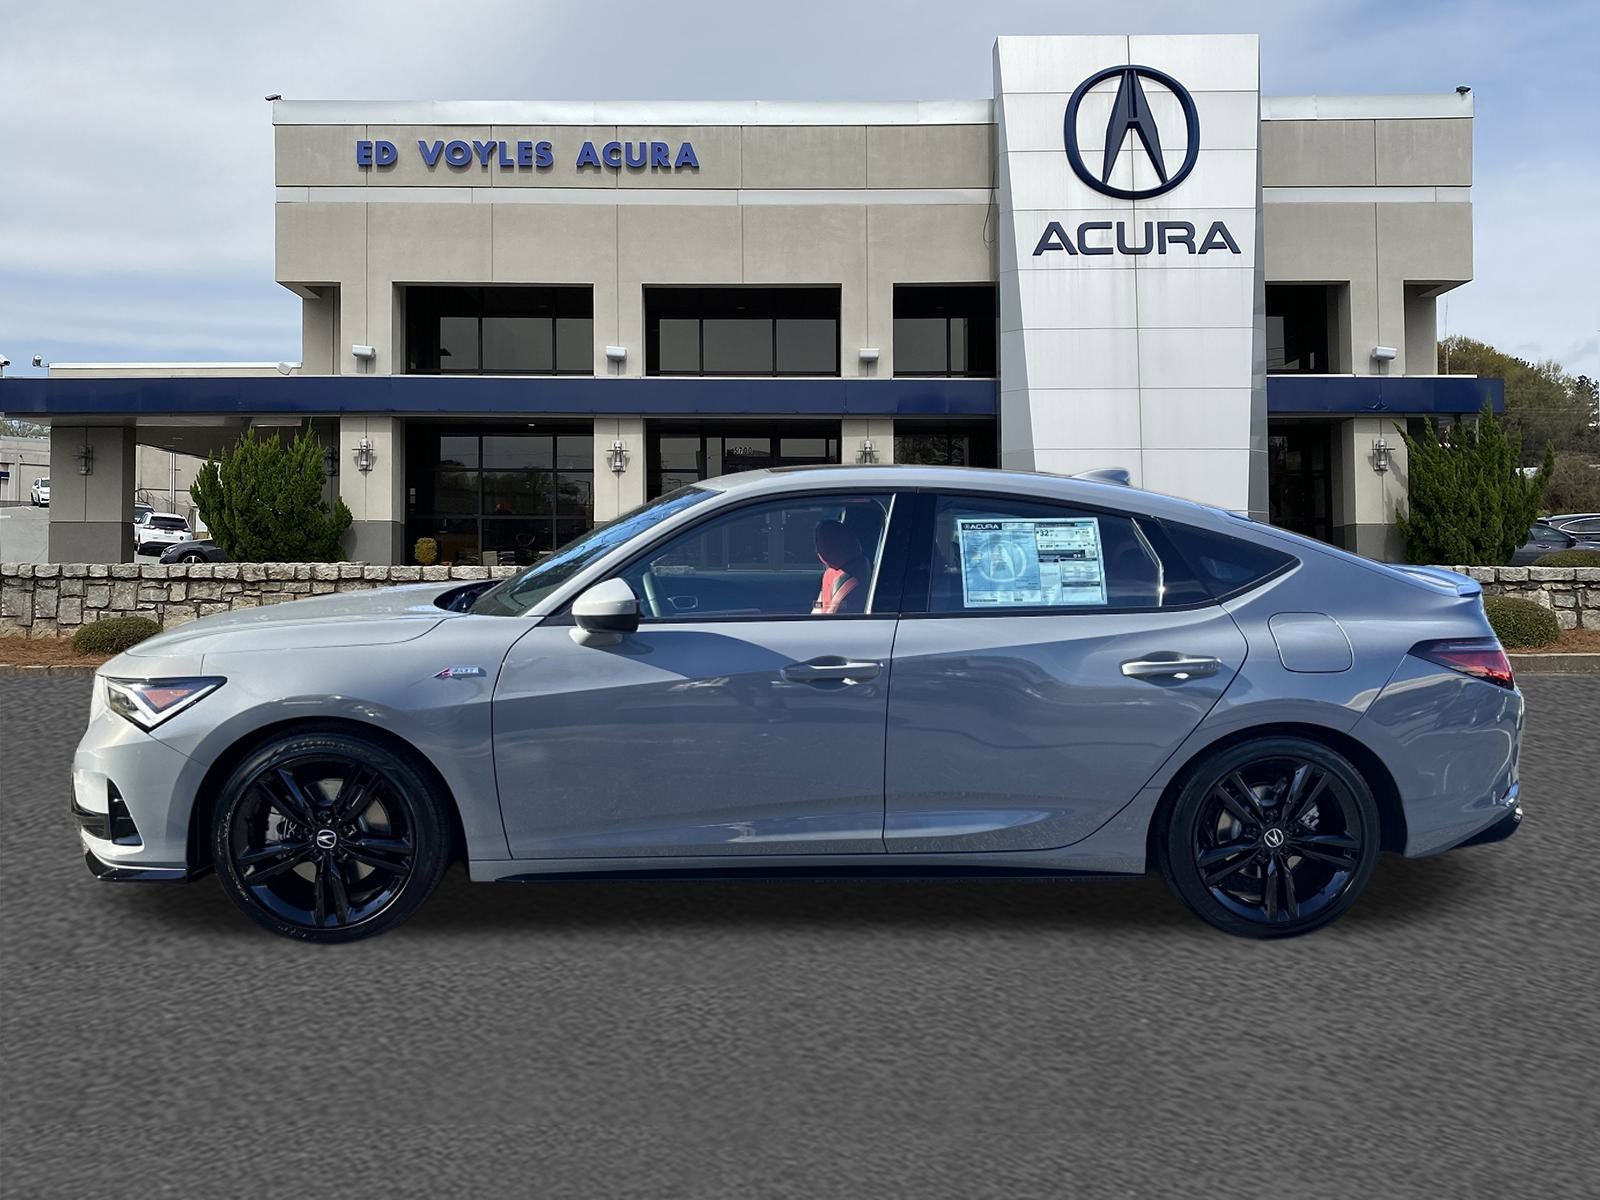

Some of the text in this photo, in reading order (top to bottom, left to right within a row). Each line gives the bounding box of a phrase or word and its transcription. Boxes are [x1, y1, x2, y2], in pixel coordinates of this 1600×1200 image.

[356, 140, 700, 169] ED VOYLES ACURA
[1032, 221, 1242, 256] ACURA
